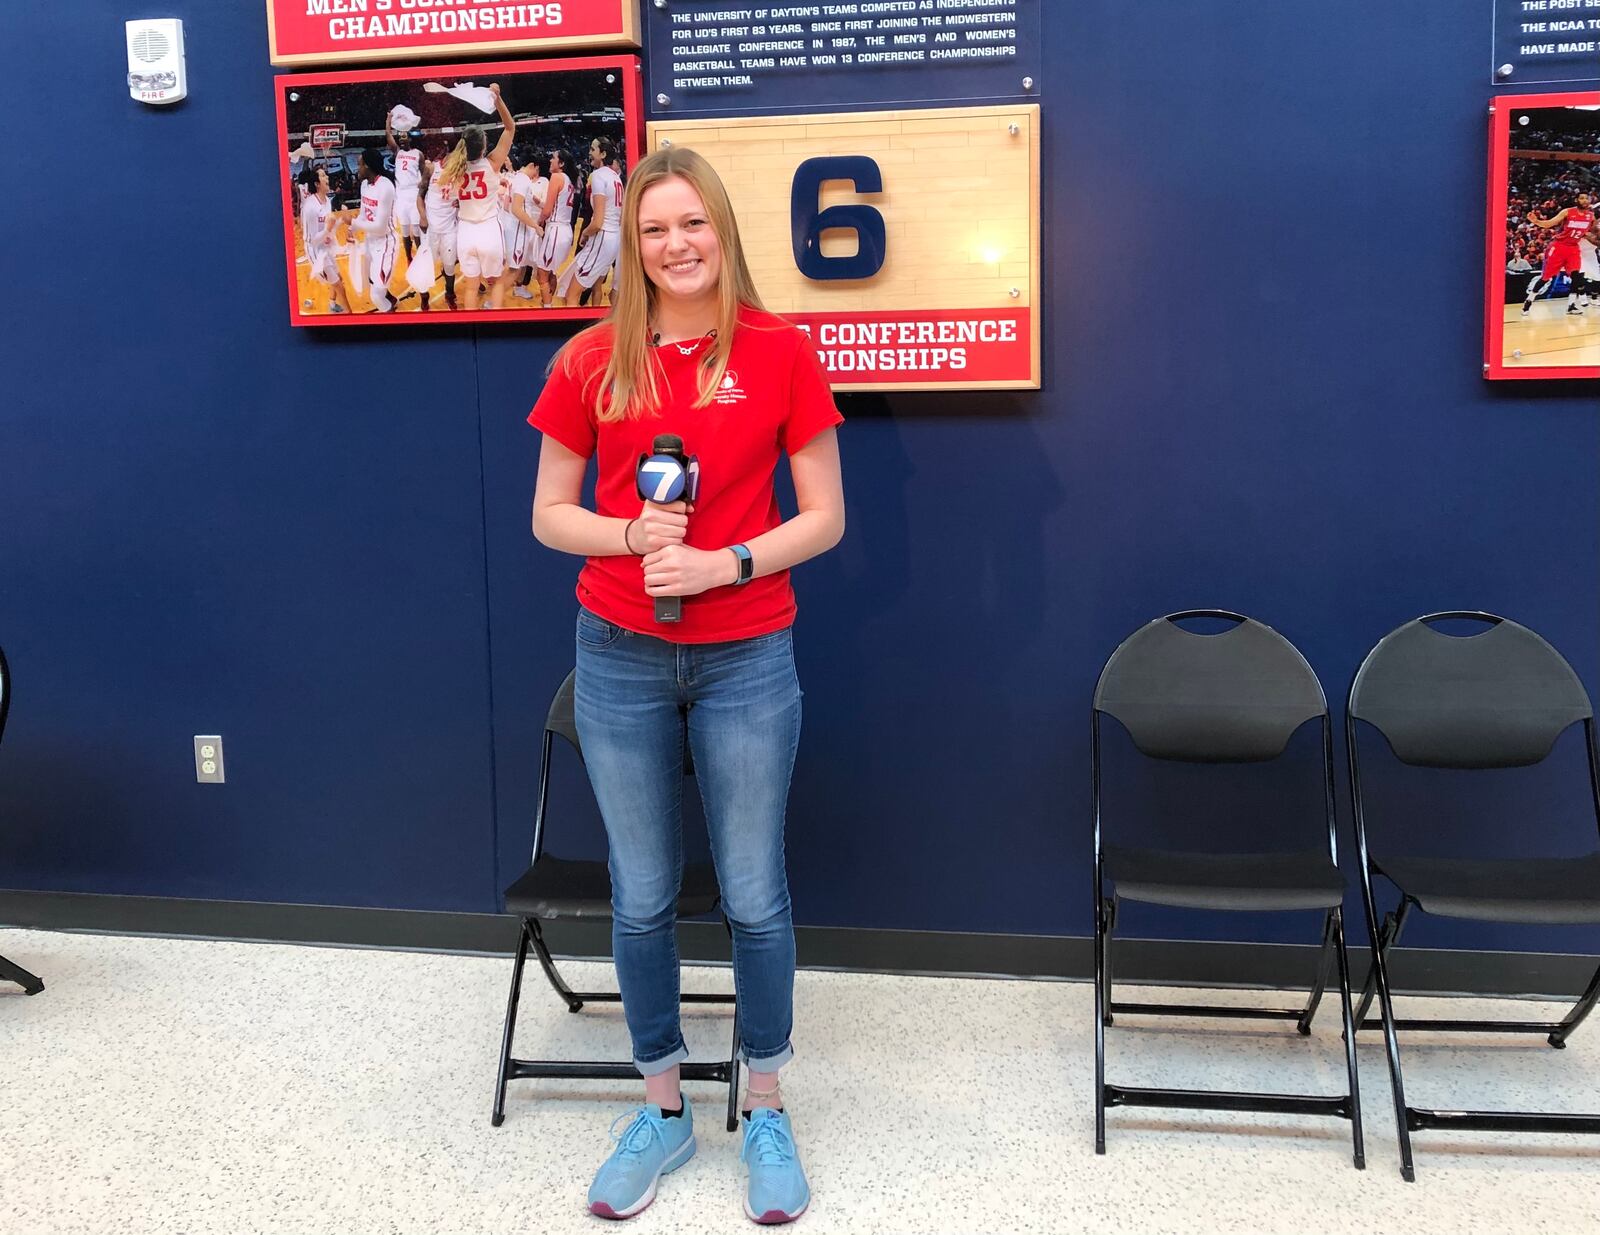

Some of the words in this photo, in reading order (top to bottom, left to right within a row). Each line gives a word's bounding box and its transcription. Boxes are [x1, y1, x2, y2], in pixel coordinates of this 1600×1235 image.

[306, 0, 391, 15] MEN
[671, 14, 691, 23] THE
[694, 10, 752, 21] UNIVERSITY
[754, 9, 768, 19] OF
[771, 6, 819, 18] DAYTON'S
[822, 4, 858, 15] TEAMS
[860, 1, 916, 13] COMPETED
[919, 0, 933, 10] AS
[1520, 1, 1547, 11] THE
[1549, 0, 1581, 10] POST
[329, 3, 562, 40] CHAMPIONSHIPS
[672, 30, 692, 39] FOR
[694, 28, 718, 38] UD'S
[721, 26, 749, 37] FIRST
[752, 25, 766, 35] 83
[769, 23, 804, 34] YEARS.
[811, 22, 841, 32] SINCE
[844, 20, 873, 30] FIRST
[876, 17, 918, 29] JOINING
[921, 16, 942, 26] THE
[945, 12, 1016, 25] MIDWESTERN
[1520, 22, 1547, 33] THE
[1549, 20, 1585, 32] NCAA
[672, 44, 731, 55] COLLEGIATE
[738, 40, 804, 52] CONFERENCE
[812, 39, 823, 48] IN
[831, 37, 857, 48] 1987,
[864, 35, 886, 46] THE
[893, 33, 926, 45] MEN'S
[934, 32, 957, 42] AND
[965, 29, 1016, 41] WOMEN'S
[1520, 44, 1555, 55] HAVE
[1558, 41, 1595, 53] MADE
[673, 60, 735, 72] BASKETBALL
[739, 58, 775, 68] TEAMS
[780, 56, 807, 66] HAVE
[811, 55, 836, 65] WON
[841, 54, 853, 63] 13
[857, 50, 925, 63] CONFERENCE
[930, 46, 1016, 59] CHAMPIONSHIPS
[141, 90, 165, 99] FIRE
[673, 77, 721, 88] BETWEEN
[722, 75, 753, 85] THEM.
[459, 171, 487, 200] 23
[791, 155, 886, 280] 6
[820, 320, 1016, 346] CONFERENCE
[641, 461, 682, 501] 7
